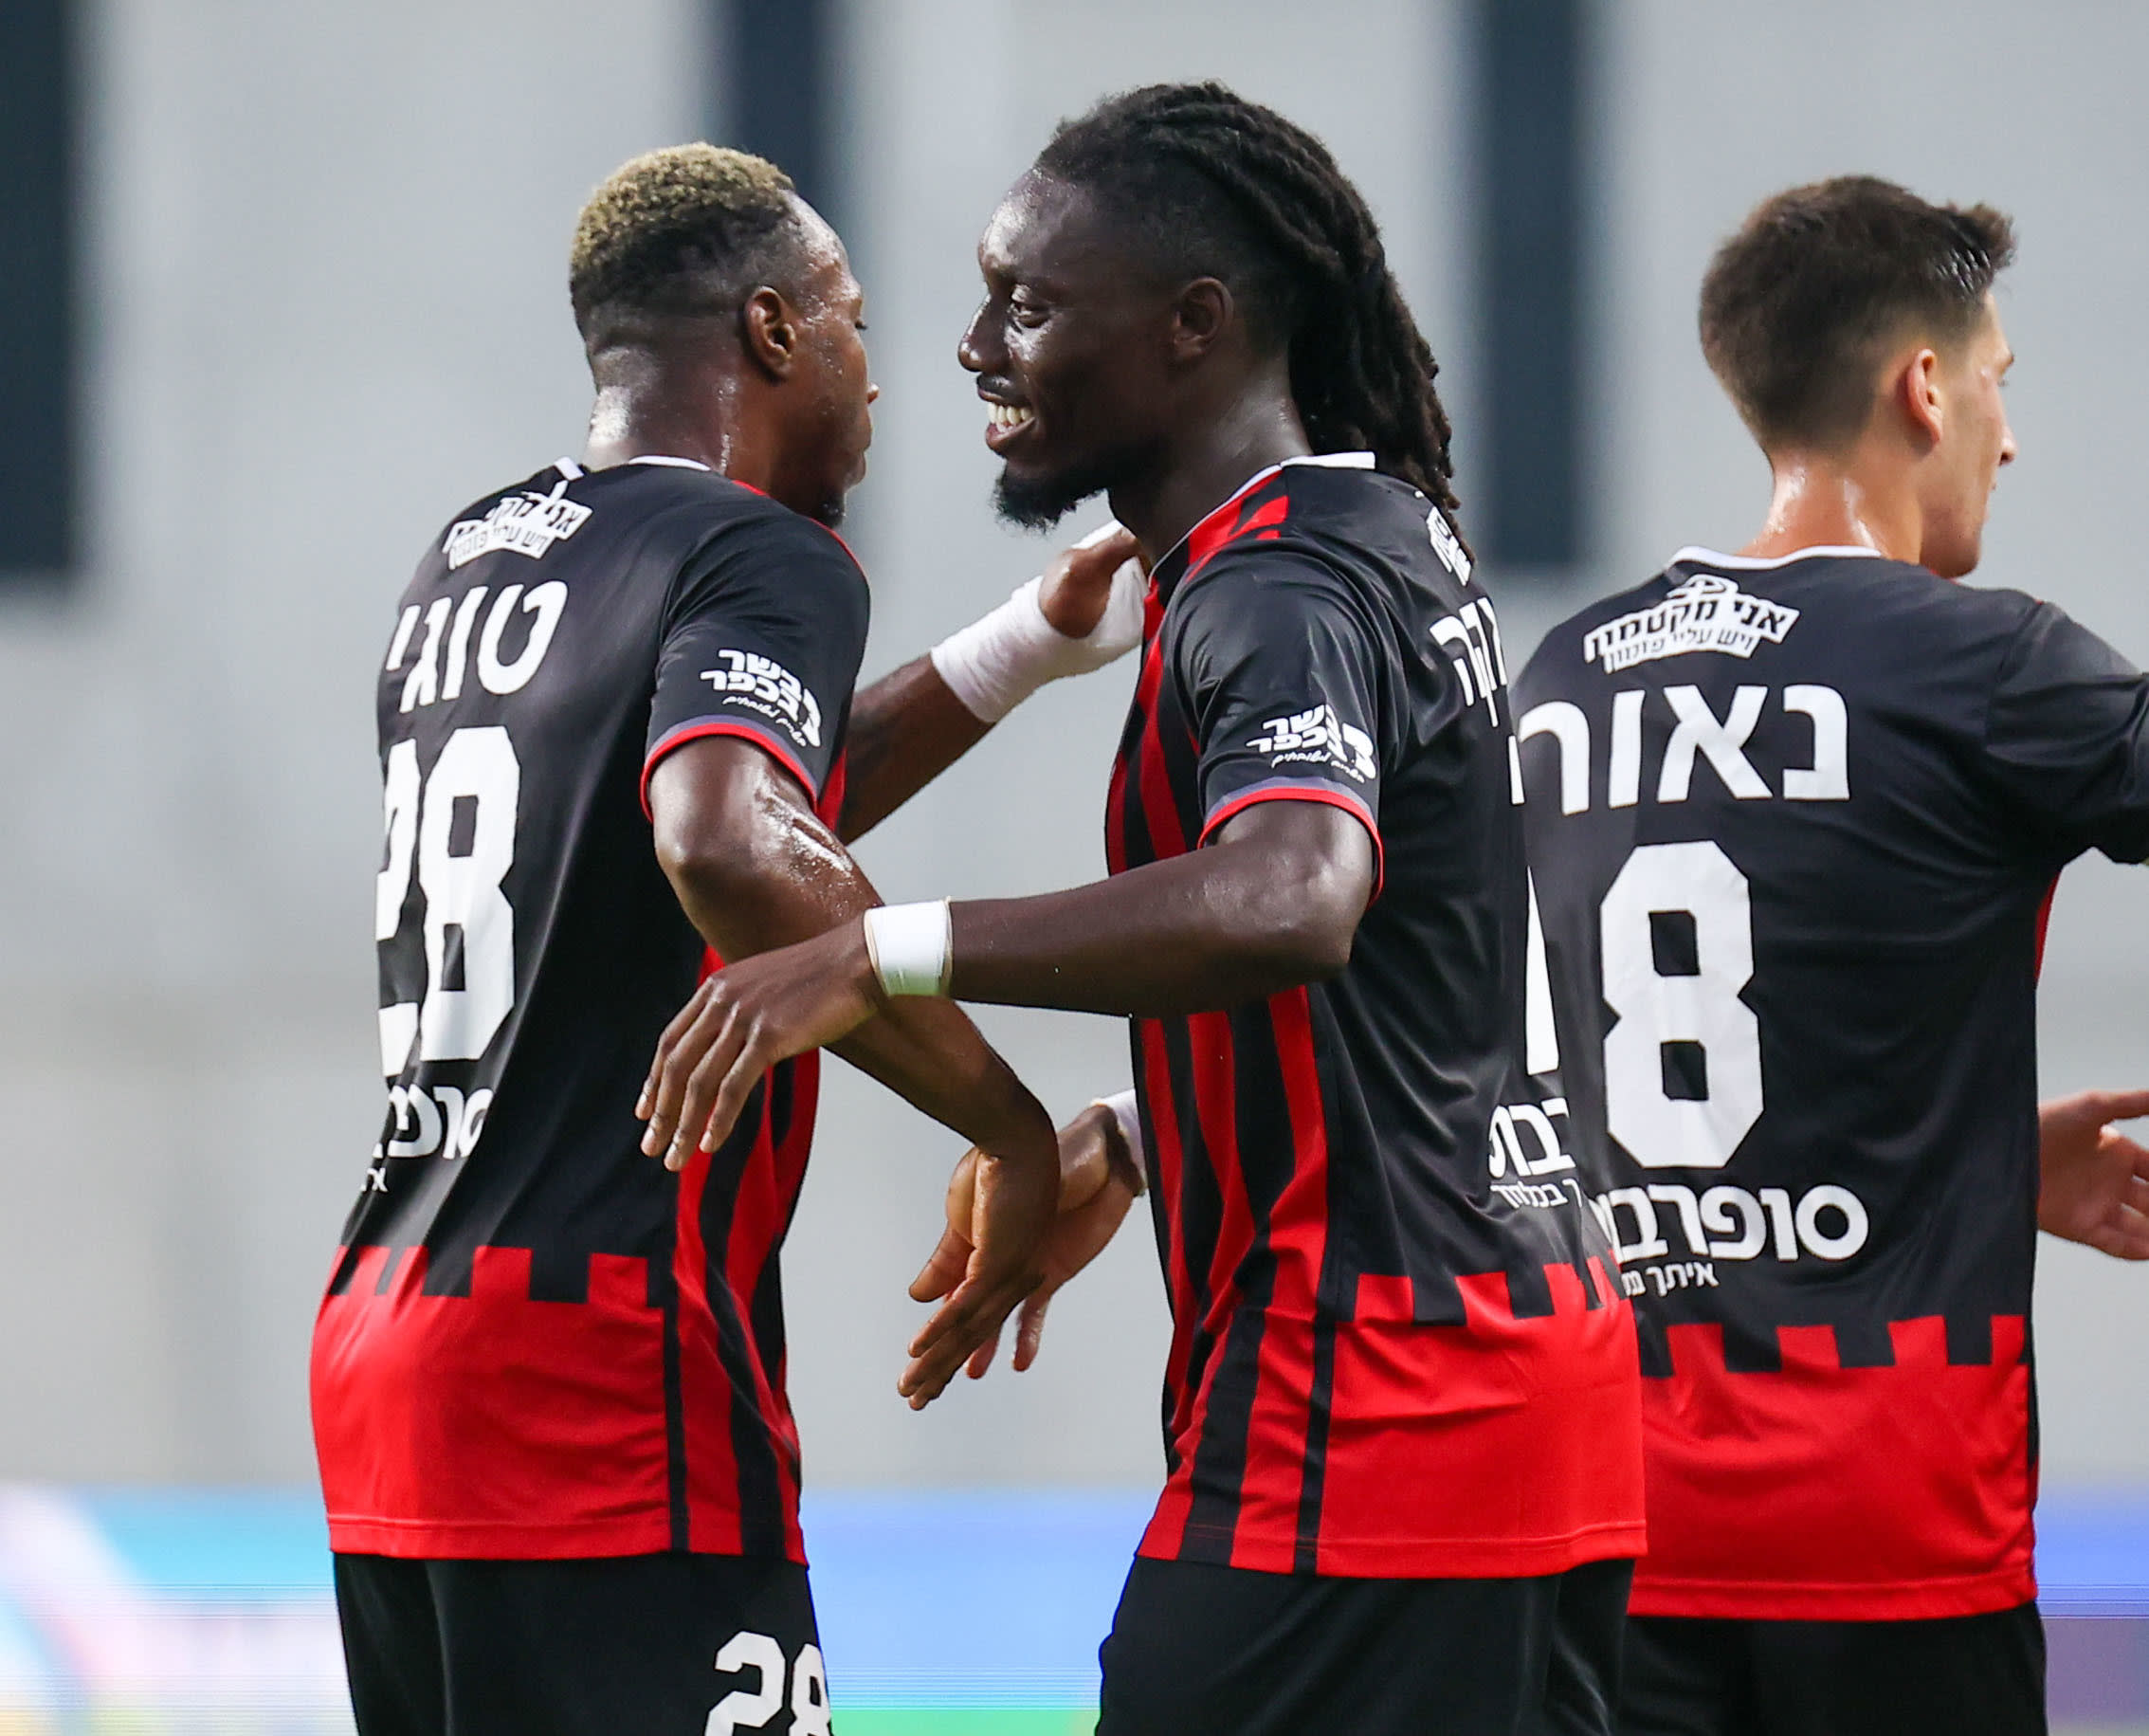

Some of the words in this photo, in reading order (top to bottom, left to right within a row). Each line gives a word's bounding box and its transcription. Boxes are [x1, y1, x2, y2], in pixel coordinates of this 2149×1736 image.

[1592, 599, 1721, 658] מקטמון
[1717, 627, 1754, 652] ויש
[1732, 599, 1787, 634] אני
[1520, 684, 1850, 816] נאור
[376, 725, 521, 1078] 28
[1599, 840, 1766, 1169] 8
[1645, 1261, 1721, 1298] איתך
[704, 1630, 832, 1736] 28
